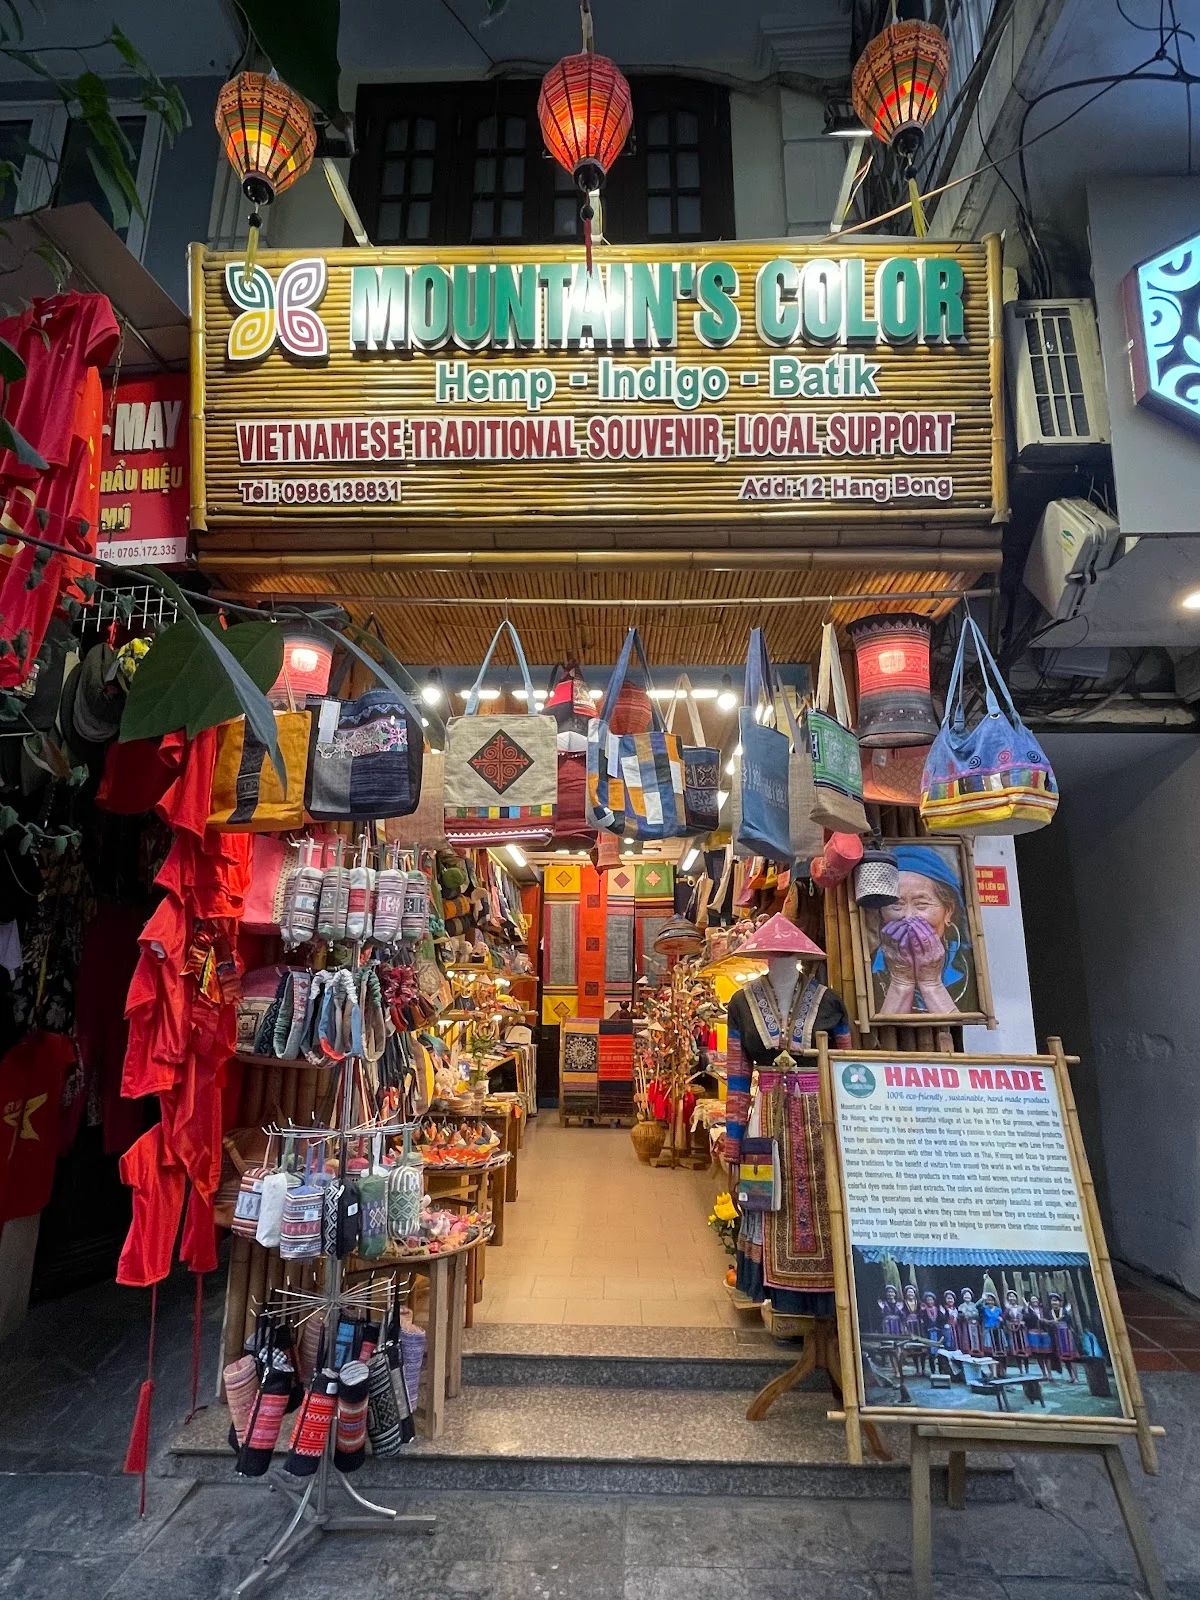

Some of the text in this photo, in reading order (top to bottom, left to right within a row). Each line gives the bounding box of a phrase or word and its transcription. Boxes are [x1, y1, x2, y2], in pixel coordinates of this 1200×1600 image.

[350, 257, 966, 347] MOUNTAIN'S COLOR
[437, 362, 554, 410] Hemp
[601, 359, 728, 407] Indigo
[772, 355, 878, 396] Batik
[114, 400, 182, 450] MAY
[239, 414, 953, 461] VIETNAMESE TRADITIONAL SOUVENIR, LOCAL SUPPORT
[283, 481, 399, 501] 0986138831
[742, 476, 951, 500] Add: 12 Hang Bong
[99, 544, 177, 559] Tel: 0705.172.335
[884, 1066, 1047, 1092] HAND MADE
[887, 1091, 904, 1100] 100%
[906, 1092, 944, 1102] eco-friendly
